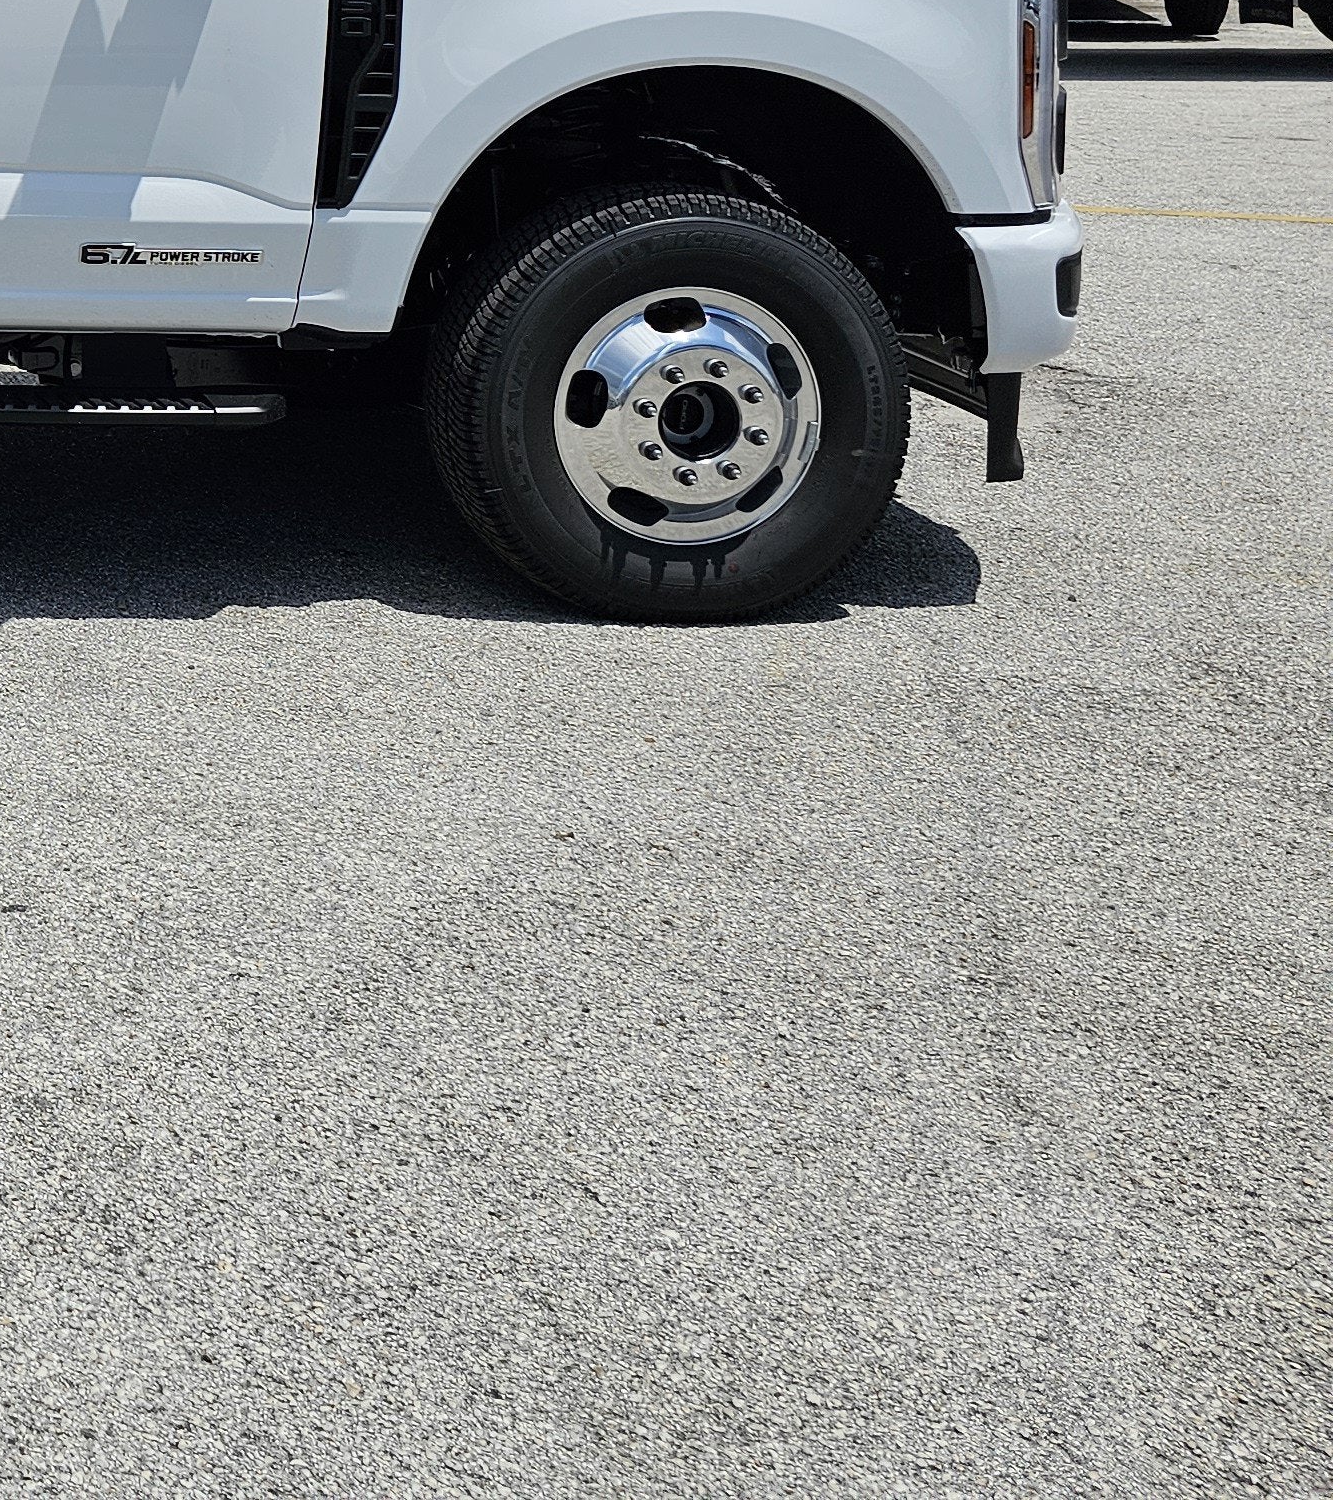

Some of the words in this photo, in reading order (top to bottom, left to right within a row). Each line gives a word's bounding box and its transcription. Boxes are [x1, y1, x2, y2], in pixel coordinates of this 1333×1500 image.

[80, 244, 147, 265] 6.7L
[149, 251, 199, 262] POWER
[203, 251, 261, 263] STROKE
